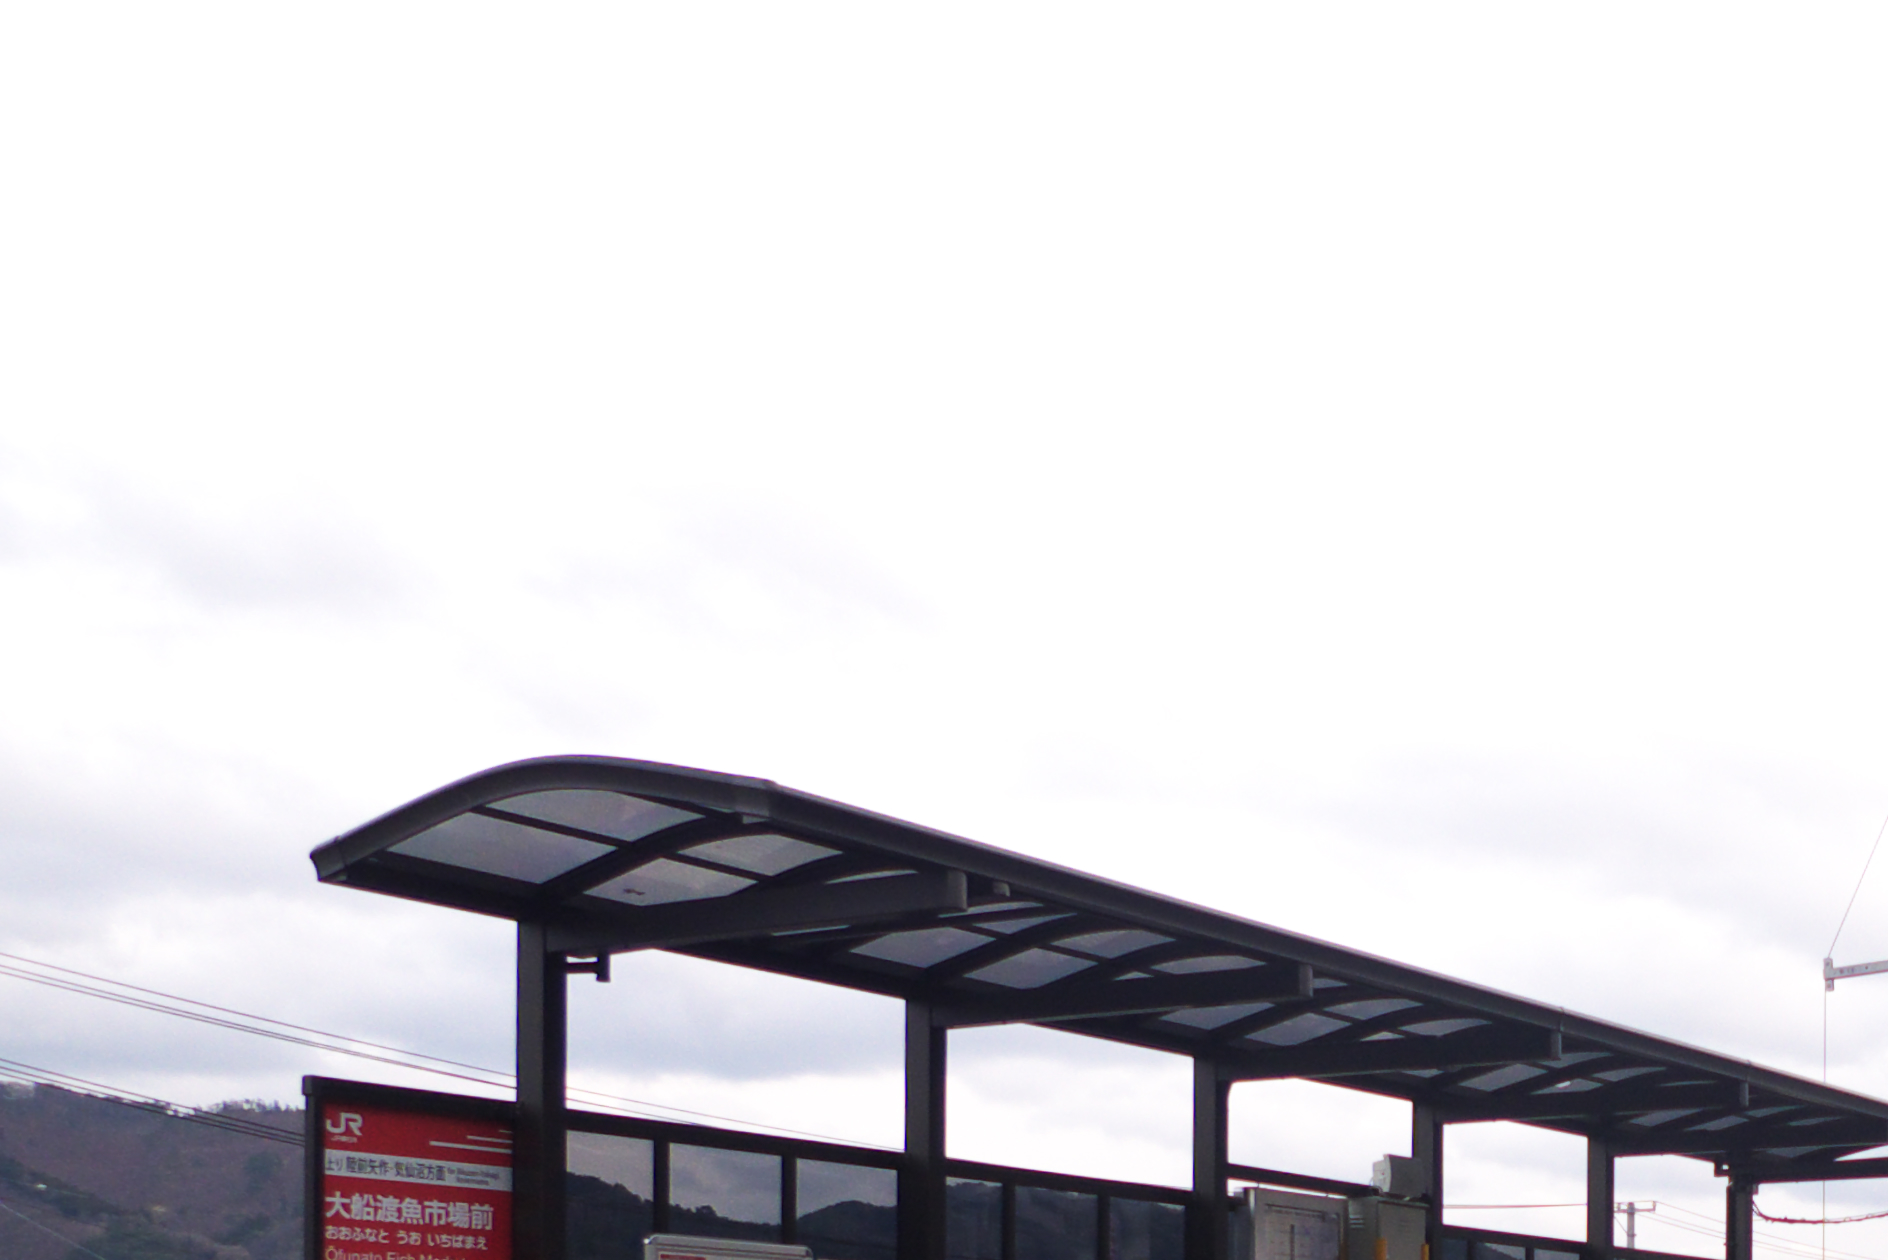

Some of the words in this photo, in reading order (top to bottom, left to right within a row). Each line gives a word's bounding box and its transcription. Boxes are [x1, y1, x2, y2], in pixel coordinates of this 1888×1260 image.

[326, 1112, 363, 1136] JR
[325, 1190, 494, 1231] 大船渡魚市場前
[324, 1225, 390, 1244] おおふなと
[396, 1230, 422, 1246] うお
[427, 1232, 488, 1250] いちばまえ
